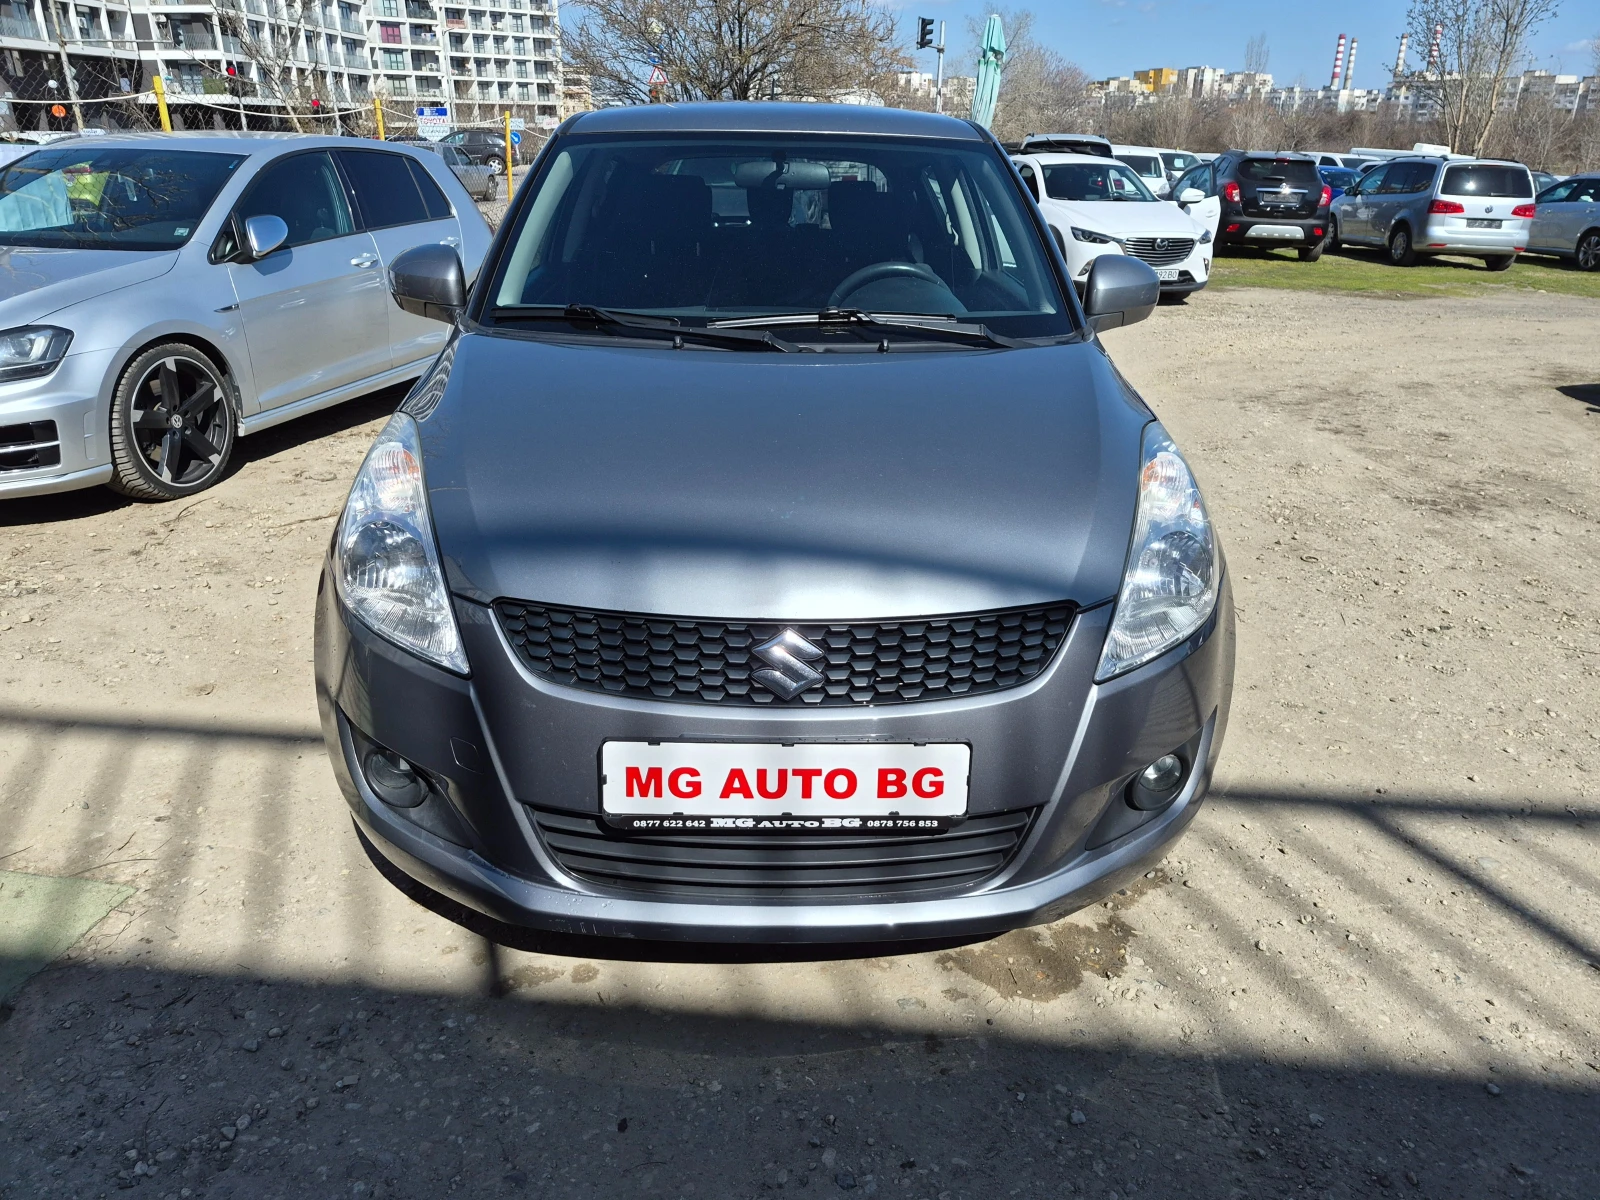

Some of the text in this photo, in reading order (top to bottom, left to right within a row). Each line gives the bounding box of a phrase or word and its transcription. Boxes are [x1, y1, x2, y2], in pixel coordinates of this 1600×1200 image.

[419, 117, 446, 125] TOYOTA
[625, 766, 945, 800] MG AUTO BG
[633, 817, 939, 828] 0877 622 642 MG AUTO BG 0878 756 853
